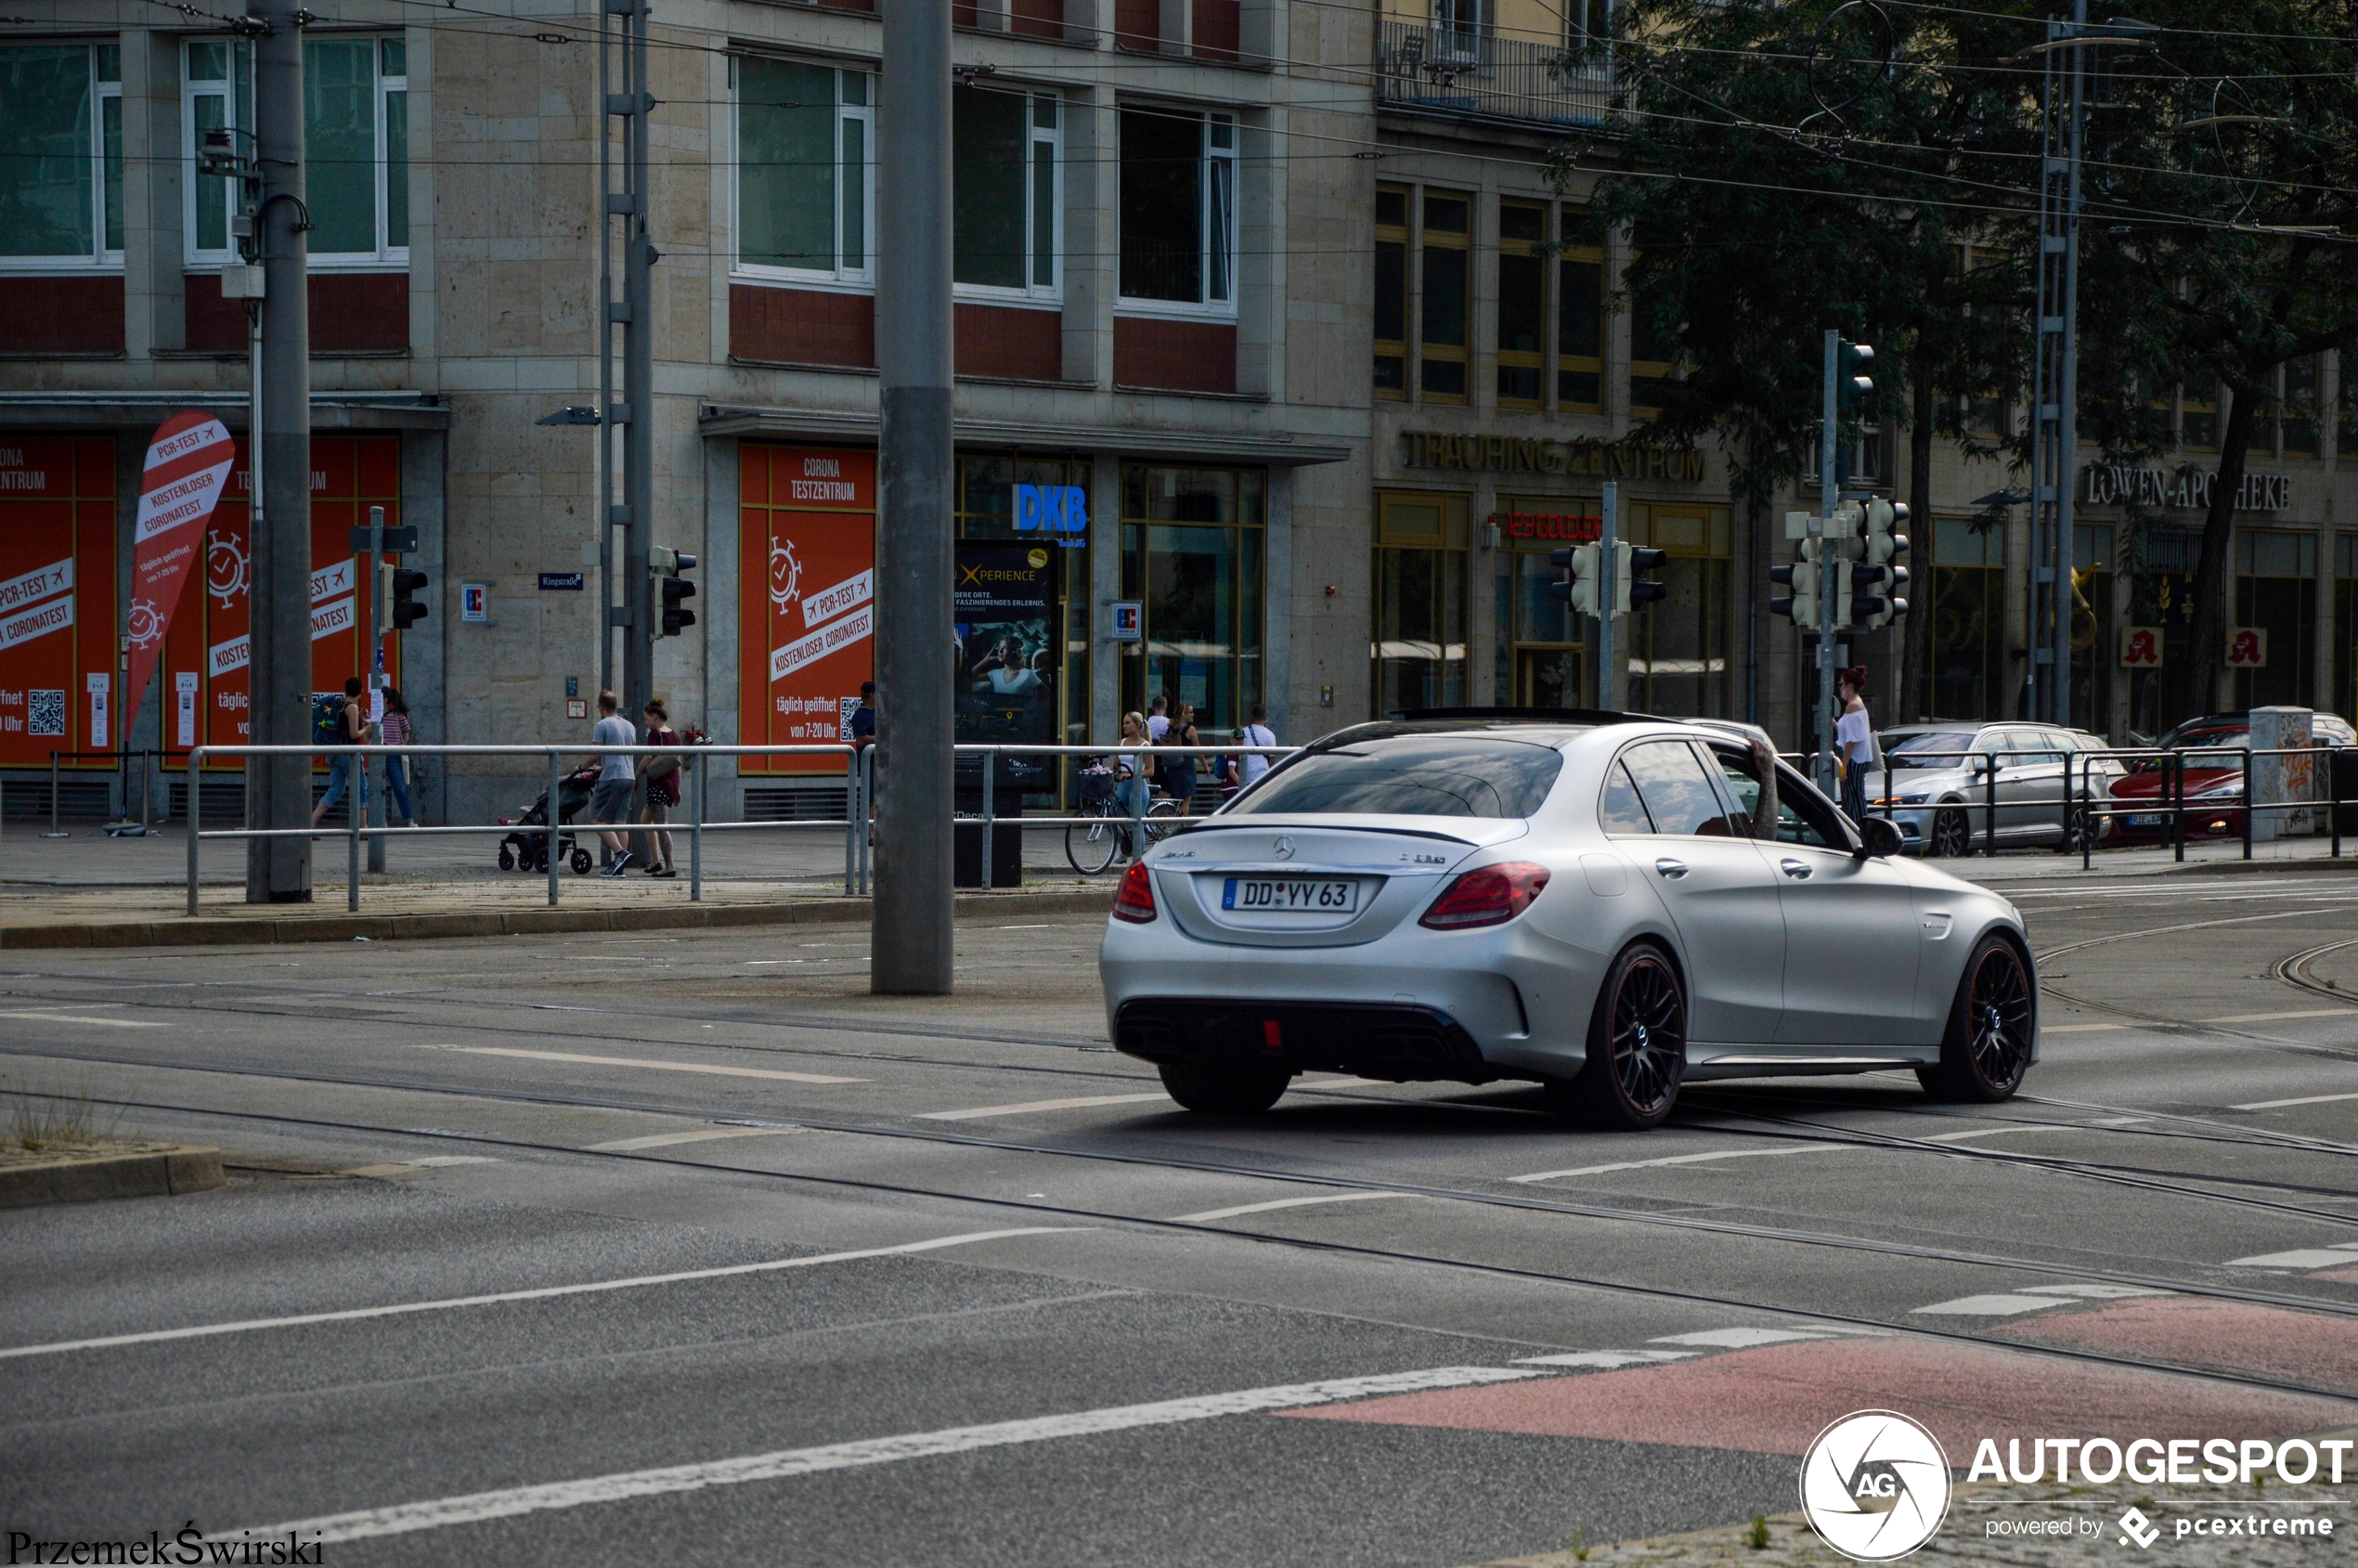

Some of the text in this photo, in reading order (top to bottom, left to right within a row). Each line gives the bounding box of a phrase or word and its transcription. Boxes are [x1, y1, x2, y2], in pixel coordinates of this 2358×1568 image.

[157, 431, 201, 459] PCR-TEST
[1401, 430, 1560, 473] TRAURING
[804, 458, 839, 477] CORONA
[150, 473, 214, 508] KOSTENLOSER
[791, 480, 854, 500] TESTZENTRUM
[144, 499, 201, 532] CORONATEST
[1013, 484, 1087, 531] DKB
[140, 545, 190, 572] täglich geöffnet
[542, 577, 577, 587] Ringstraße
[820, 584, 855, 616] PCR-TEST
[1012, 599, 1046, 607] ERLEBNIS.
[6, 604, 68, 640] CORONATEST
[774, 614, 870, 673] KOSTENLOSER CORONATEST
[218, 692, 248, 711] täglic
[776, 695, 836, 715] täglich geöffnet
[5, 716, 23, 732] Uhr
[238, 722, 249, 734] vo
[790, 722, 837, 738] von 7-20 Uhr
[1243, 883, 1347, 906] DD YY 63
